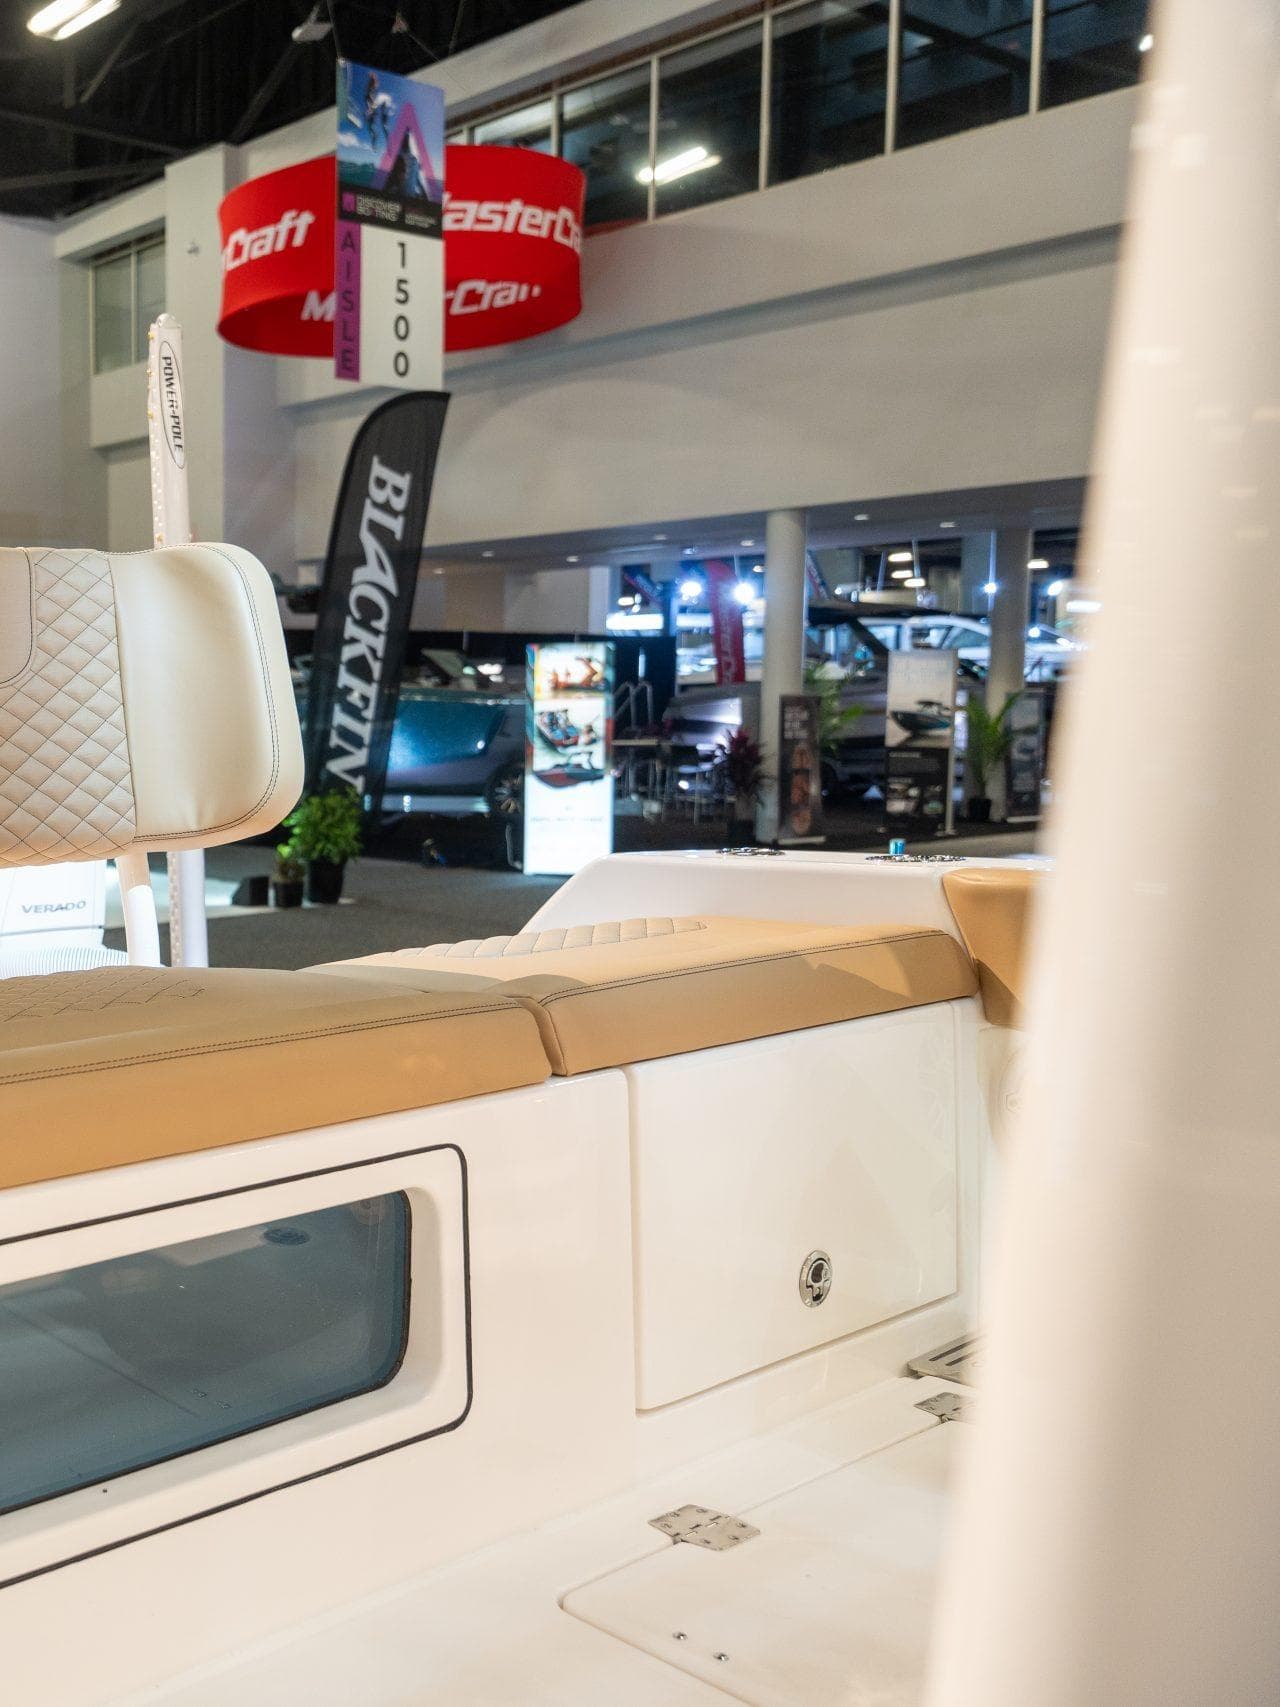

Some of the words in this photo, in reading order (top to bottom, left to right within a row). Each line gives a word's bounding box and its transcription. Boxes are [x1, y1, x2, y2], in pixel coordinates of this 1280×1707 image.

[341, 231, 356, 372] AISLE
[393, 242, 411, 379] 1500
[162, 355, 183, 450] POWER-POLE
[326, 454, 413, 797] BLACKFIN
[22, 900, 87, 914] VERADO
